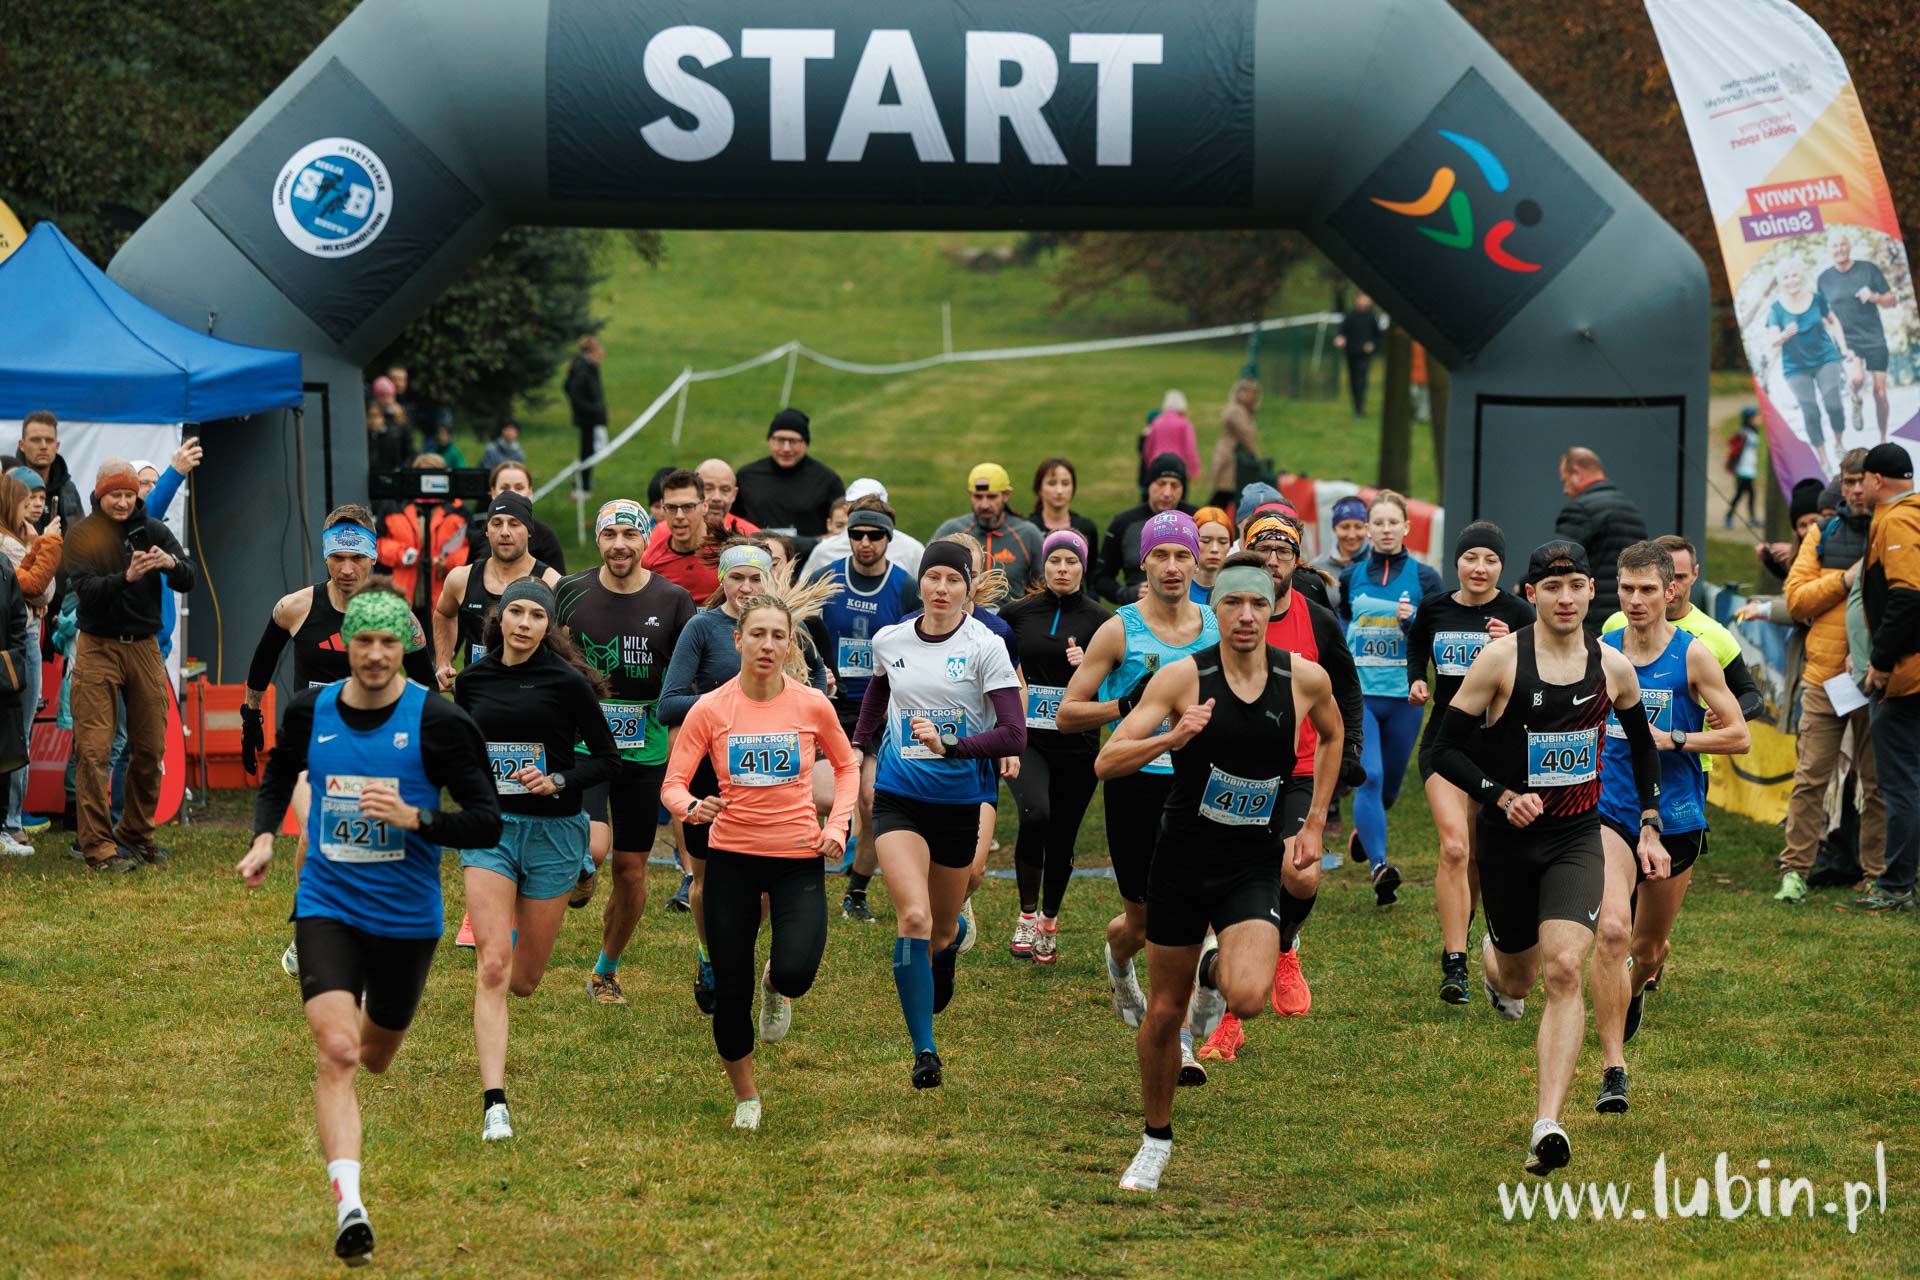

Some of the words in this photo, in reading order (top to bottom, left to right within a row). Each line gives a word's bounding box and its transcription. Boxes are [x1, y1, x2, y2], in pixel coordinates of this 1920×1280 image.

[640, 25, 1163, 166] START
[293, 168, 325, 201] S
[342, 182, 374, 219] B
[847, 598, 878, 611] KGHM
[623, 635, 649, 650] WILK
[1362, 639, 1399, 657] 401
[623, 650, 653, 664] ULTRA
[847, 650, 871, 668] 41
[623, 664, 649, 678] TEAM
[906, 709, 930, 717] LUBIN
[931, 709, 962, 717] CROSS
[609, 718, 638, 738] 28
[1536, 735, 1565, 743] LUBIN
[1567, 730, 1595, 742] CROSS
[735, 735, 762, 744] LUBIN
[764, 734, 794, 743] CROSS
[508, 744, 540, 753] CROSS
[739, 748, 791, 773] 412
[1541, 746, 1591, 772] 404
[1219, 773, 1247, 788] LUBIN
[1248, 780, 1277, 790] CROSS
[1214, 790, 1268, 815] 419
[332, 818, 389, 846] 421
